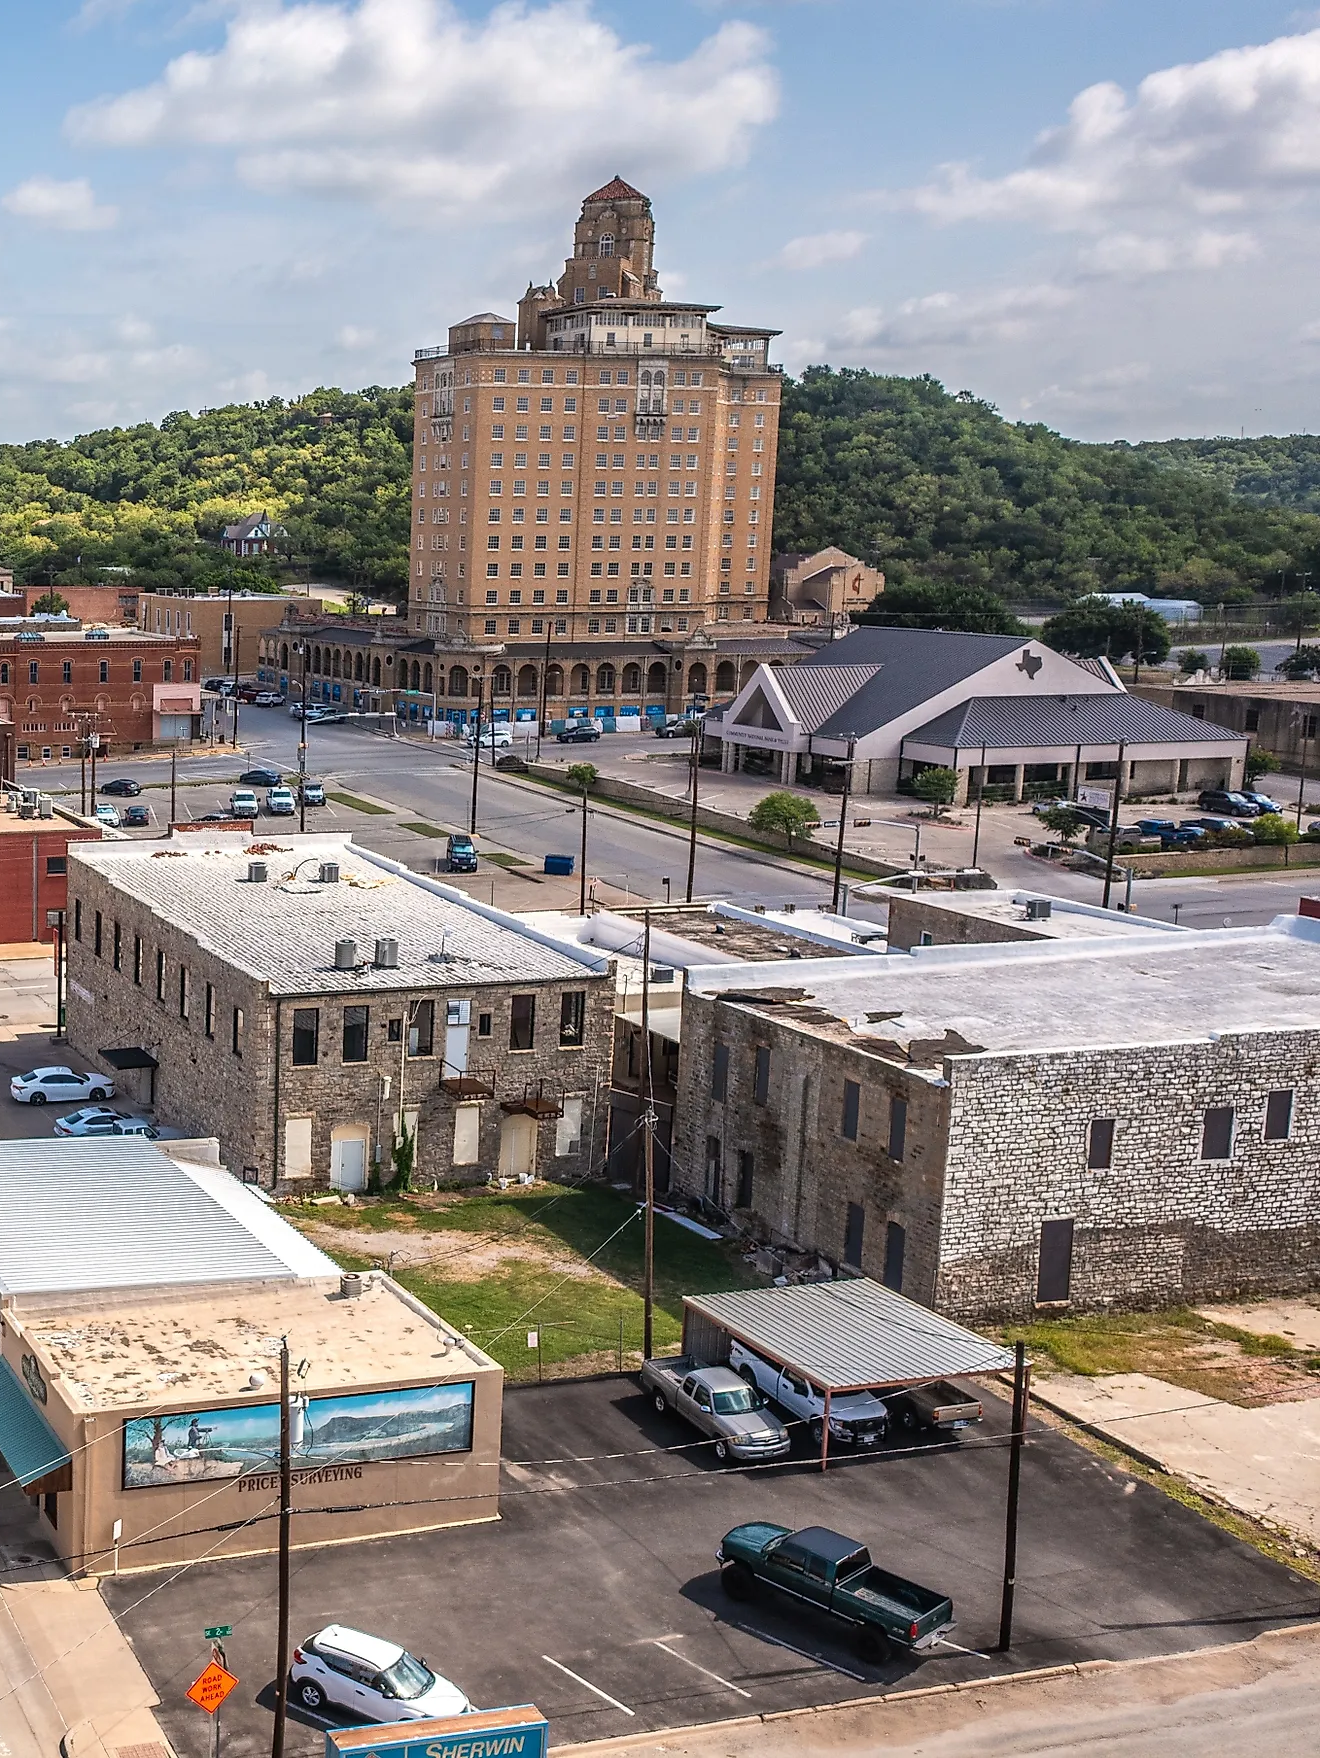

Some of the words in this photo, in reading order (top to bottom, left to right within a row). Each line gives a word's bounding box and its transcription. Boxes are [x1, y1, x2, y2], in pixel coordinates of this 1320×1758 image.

[238, 1476, 278, 1493] PRICE
[290, 1466, 363, 1487] SURVEYING
[202, 1674, 223, 1684] ROAD
[202, 1683, 222, 1693] WORK
[200, 1691, 225, 1702] AHEAD
[425, 1735, 526, 1758] SHERWIN
